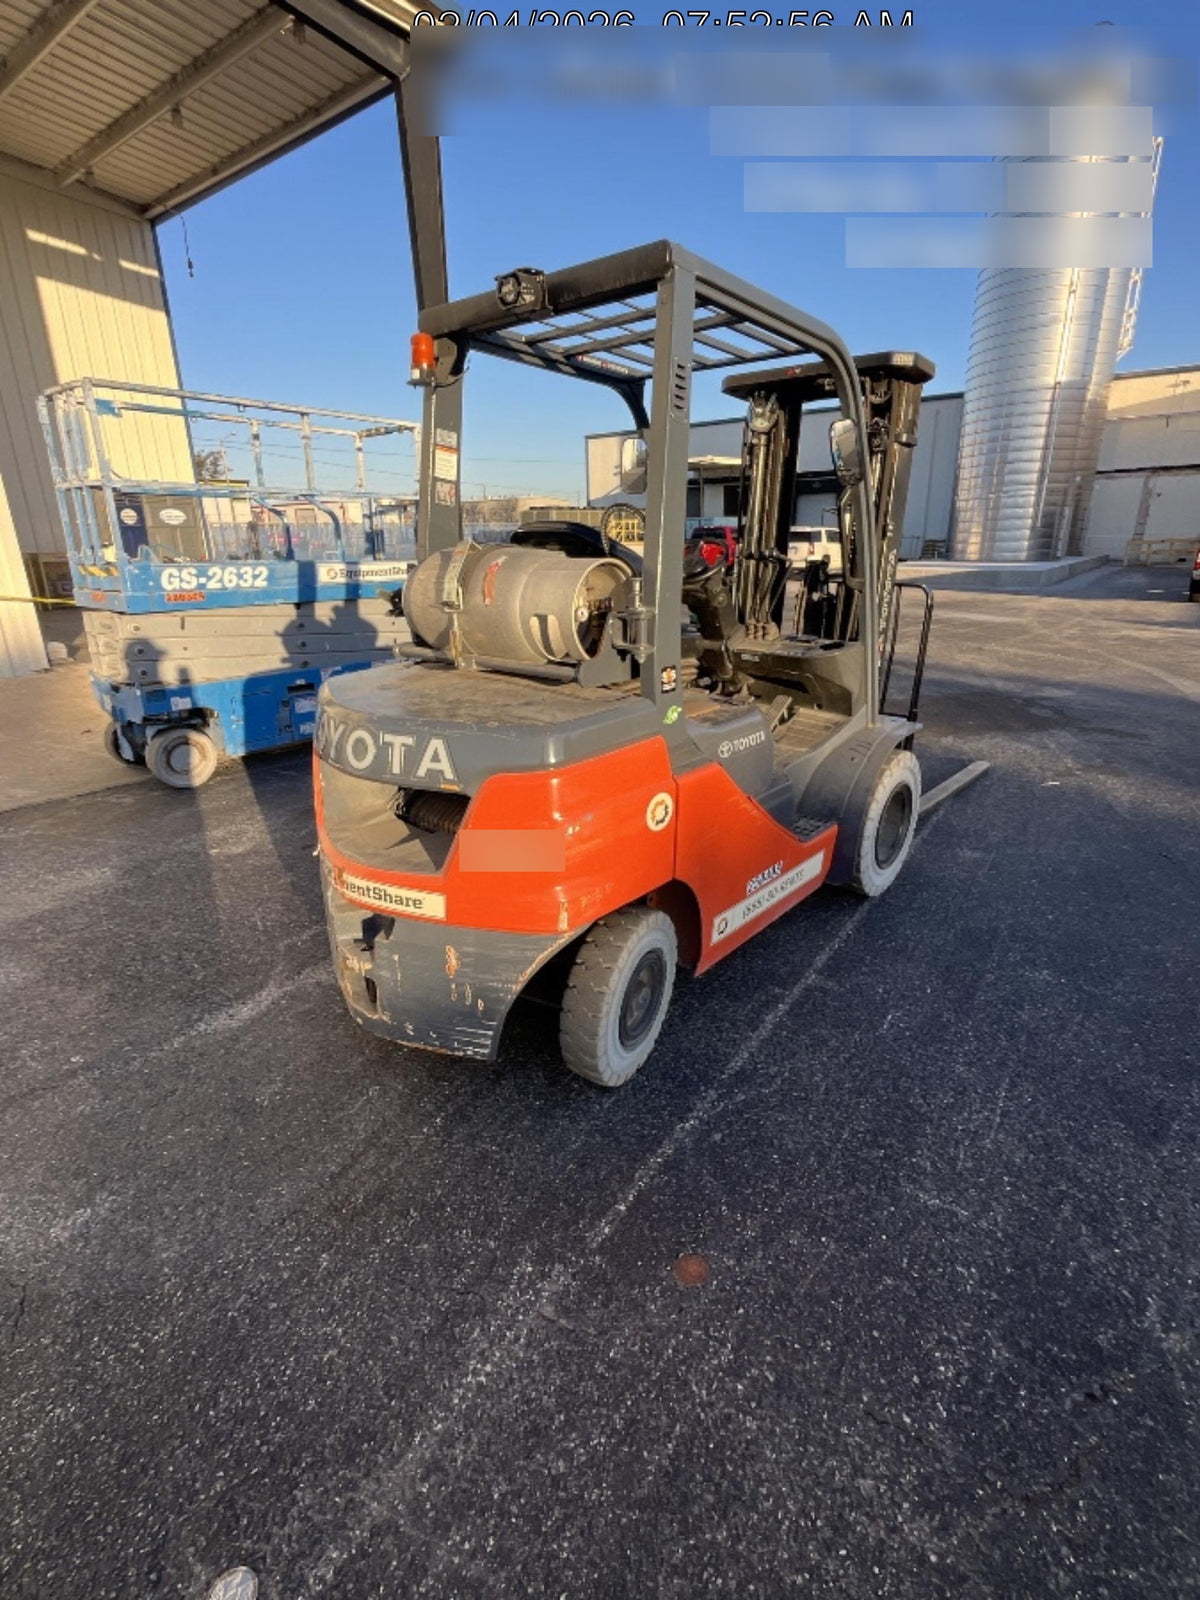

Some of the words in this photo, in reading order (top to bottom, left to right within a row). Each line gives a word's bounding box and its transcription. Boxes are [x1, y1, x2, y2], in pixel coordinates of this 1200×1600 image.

[161, 566, 268, 590] GS-2632
[732, 730, 765, 751] TOYOTA
[345, 882, 423, 909] entShare
